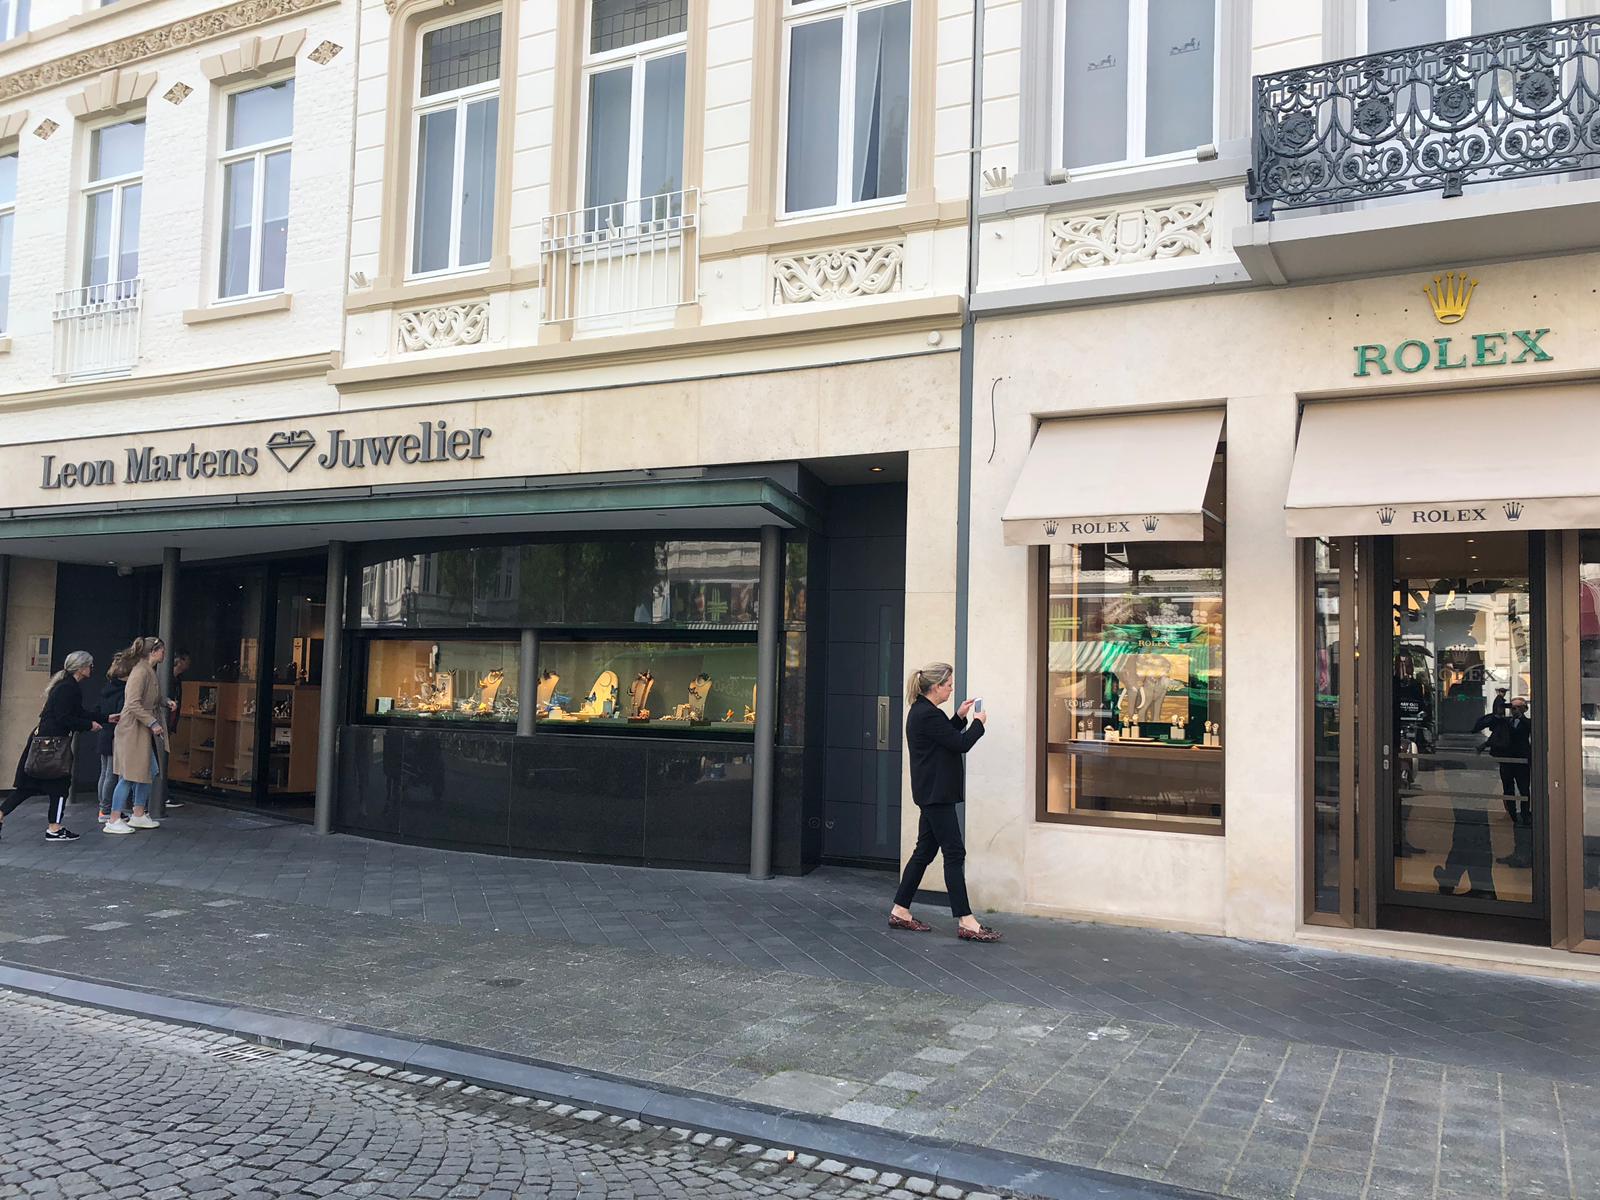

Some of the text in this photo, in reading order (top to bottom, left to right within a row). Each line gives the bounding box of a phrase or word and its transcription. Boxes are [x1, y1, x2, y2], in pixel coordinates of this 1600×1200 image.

[1353, 328, 1554, 377] ROLEX
[40, 420, 492, 489] Leon Martens Juwelier
[1411, 508, 1488, 524] ROLEX
[1071, 519, 1131, 536] ROLEX
[1138, 639, 1170, 648] ROLEX
